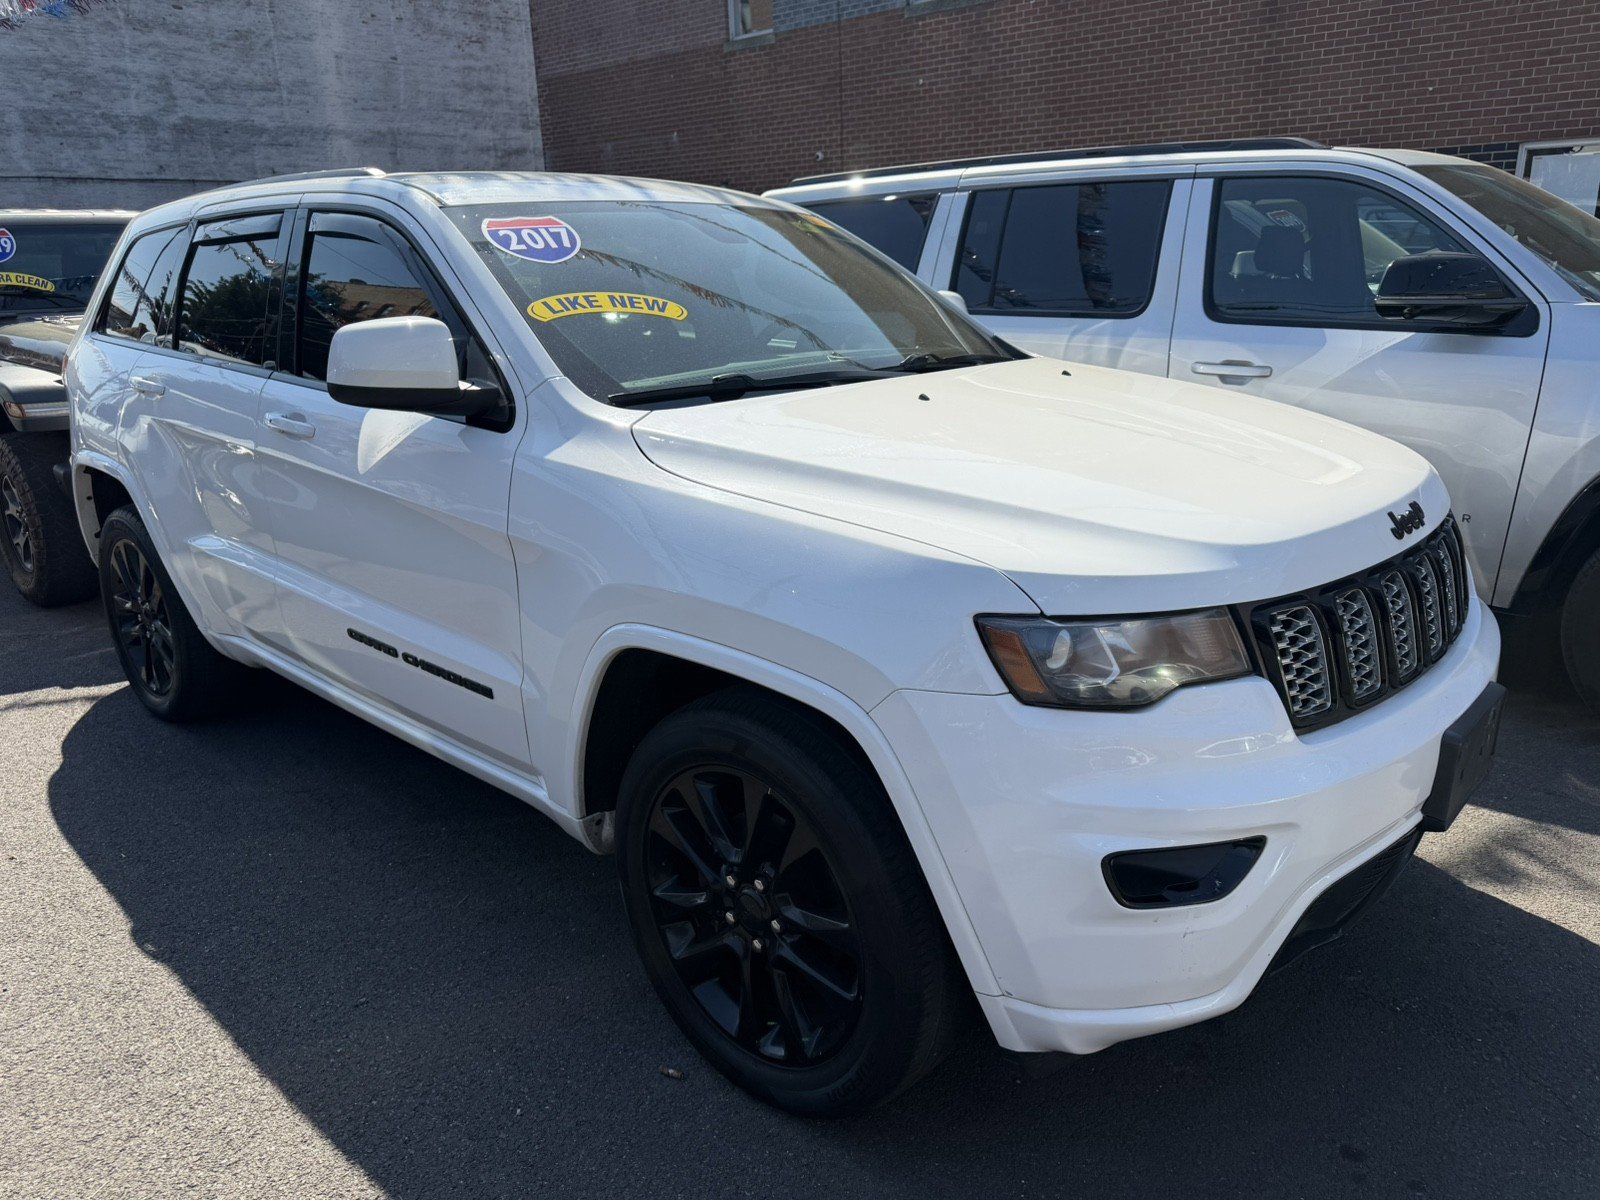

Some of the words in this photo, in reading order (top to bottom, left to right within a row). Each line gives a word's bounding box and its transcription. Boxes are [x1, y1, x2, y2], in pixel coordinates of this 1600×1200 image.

[498, 227, 572, 251] 2017
[15, 274, 49, 289] CLEAN
[541, 294, 602, 315] LIKE
[609, 294, 669, 313] NEW
[1387, 500, 1426, 541] Jeep
[1461, 513, 1472, 524] R
